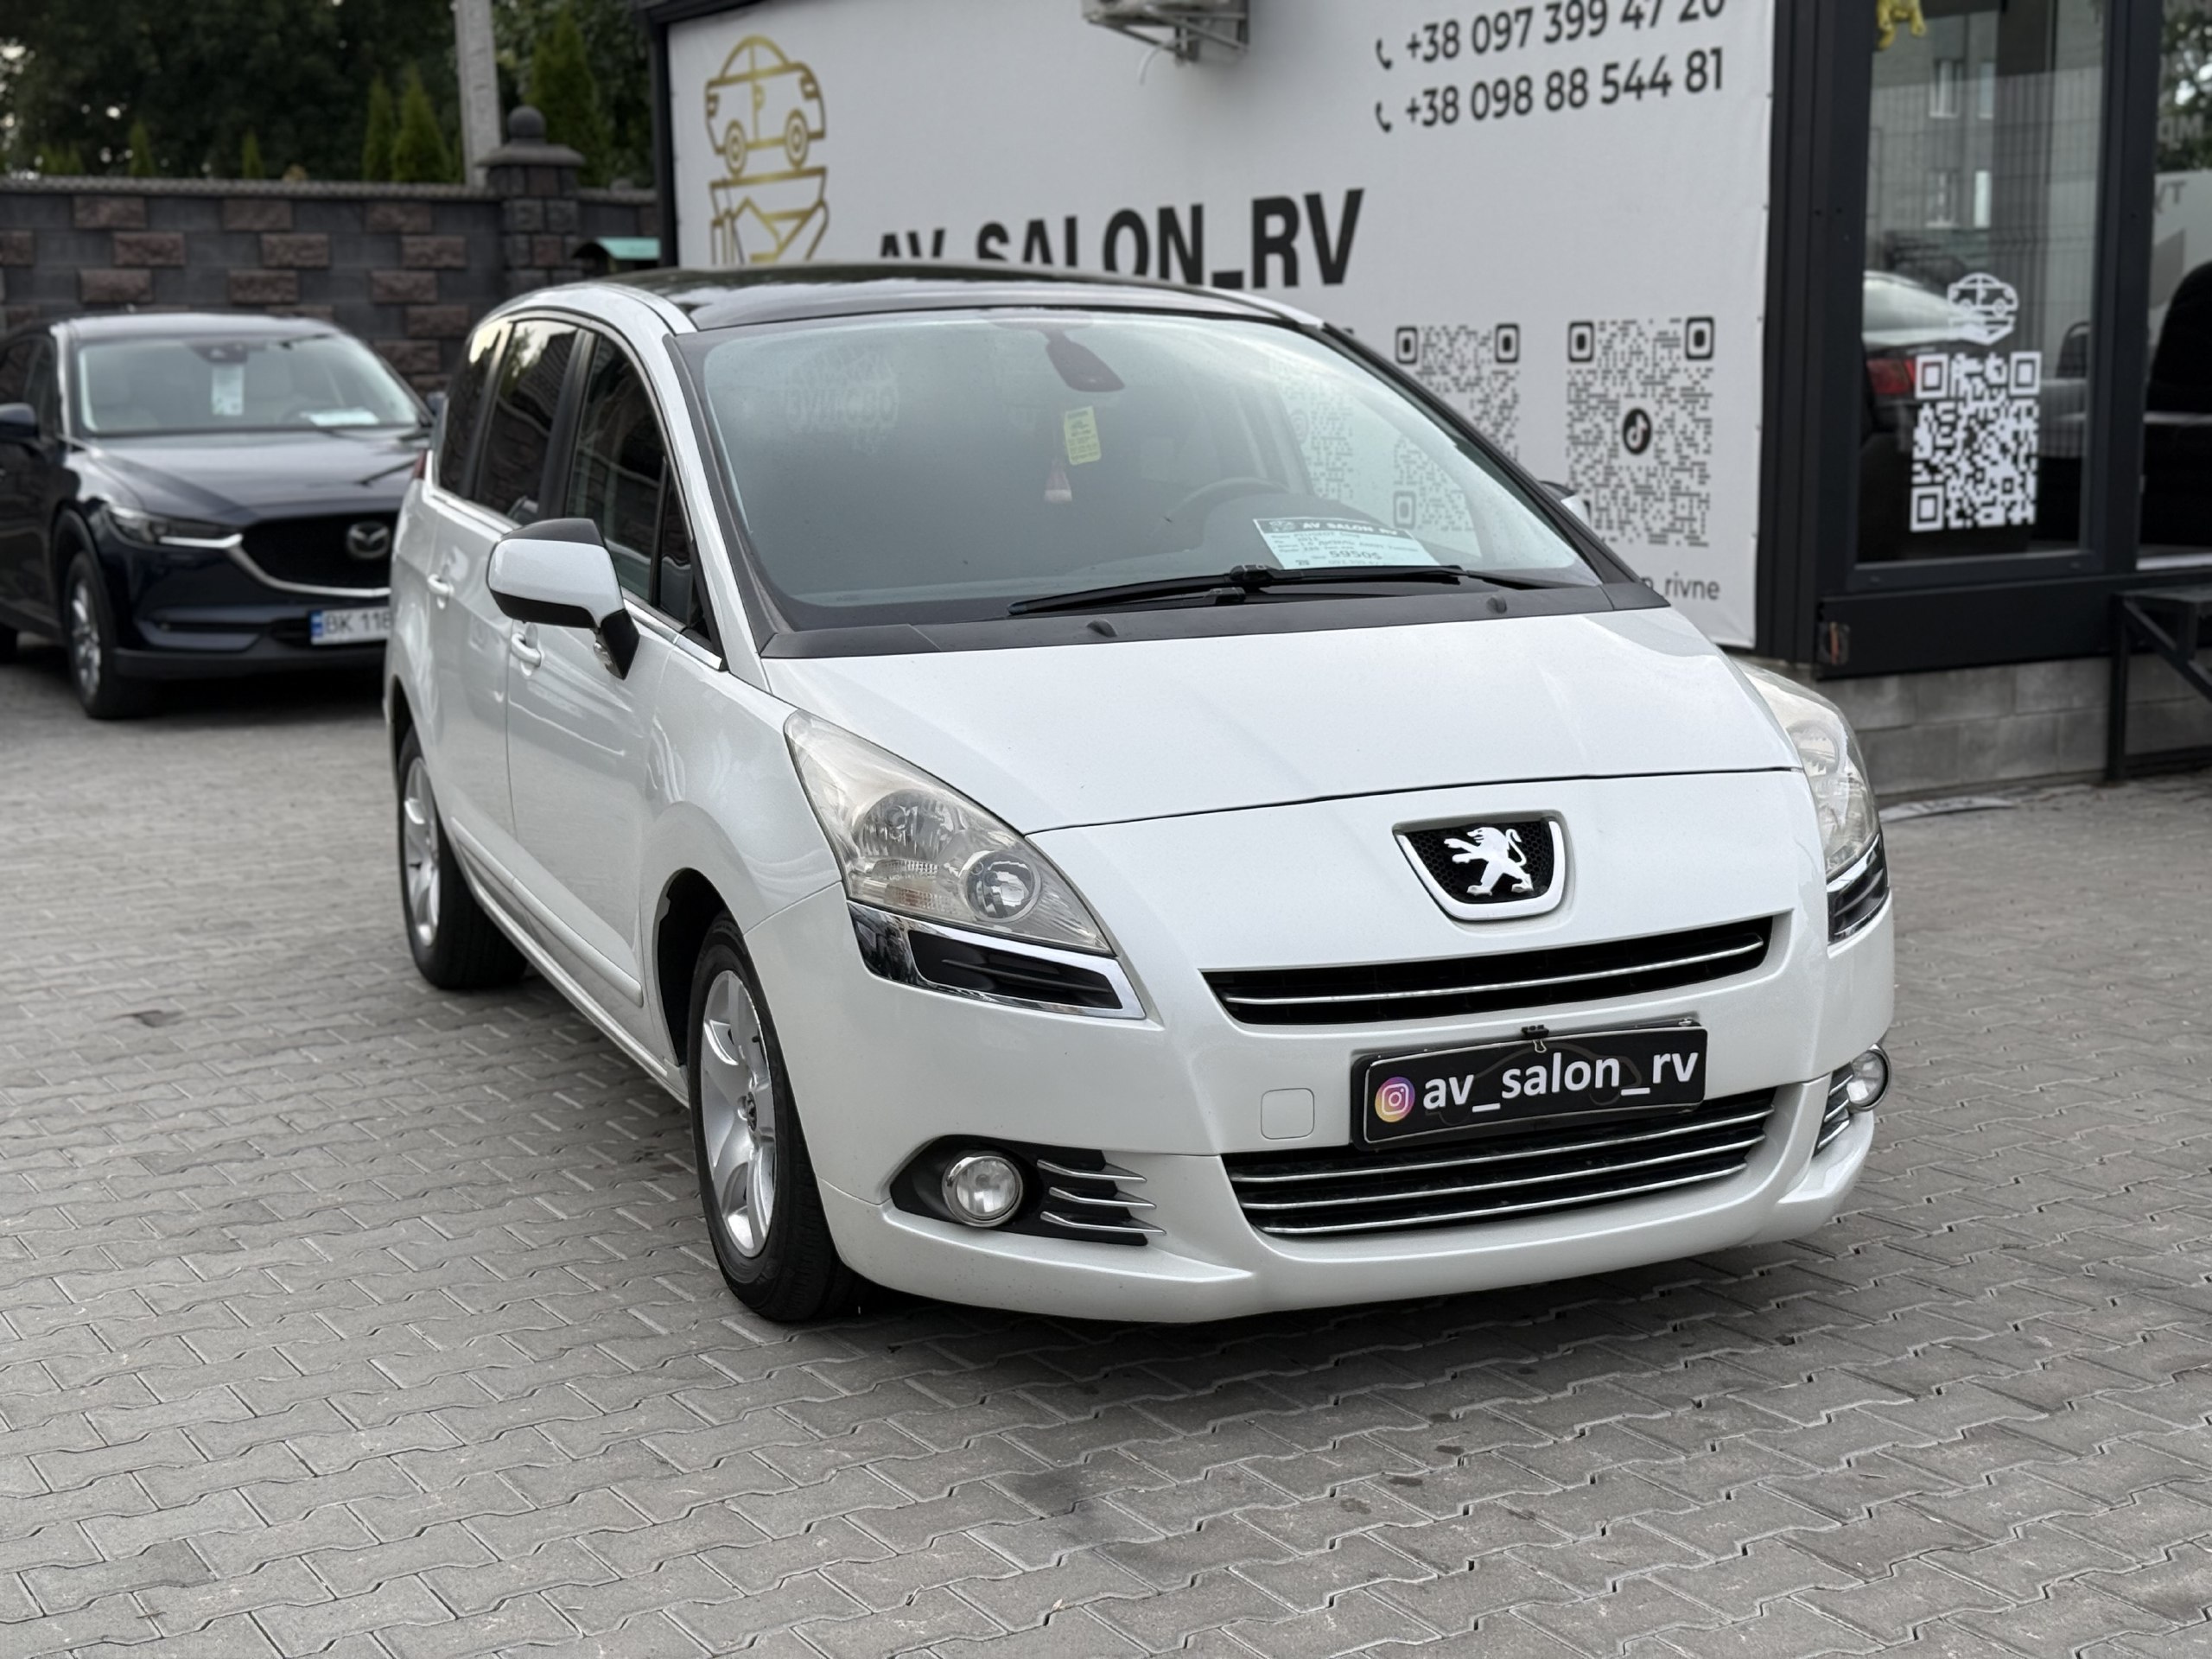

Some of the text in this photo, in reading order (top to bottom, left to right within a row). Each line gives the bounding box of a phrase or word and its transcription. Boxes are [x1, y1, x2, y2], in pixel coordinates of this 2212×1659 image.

[1406, 20, 1460, 62] +38
[1471, 8, 1534, 54] 097
[1544, 0, 1608, 43] 399
[1620, 0, 1664, 29] 47
[1406, 47, 1723, 127] +38 098 88 544 81
[1423, 1052, 1699, 1113] av_salon_rv
